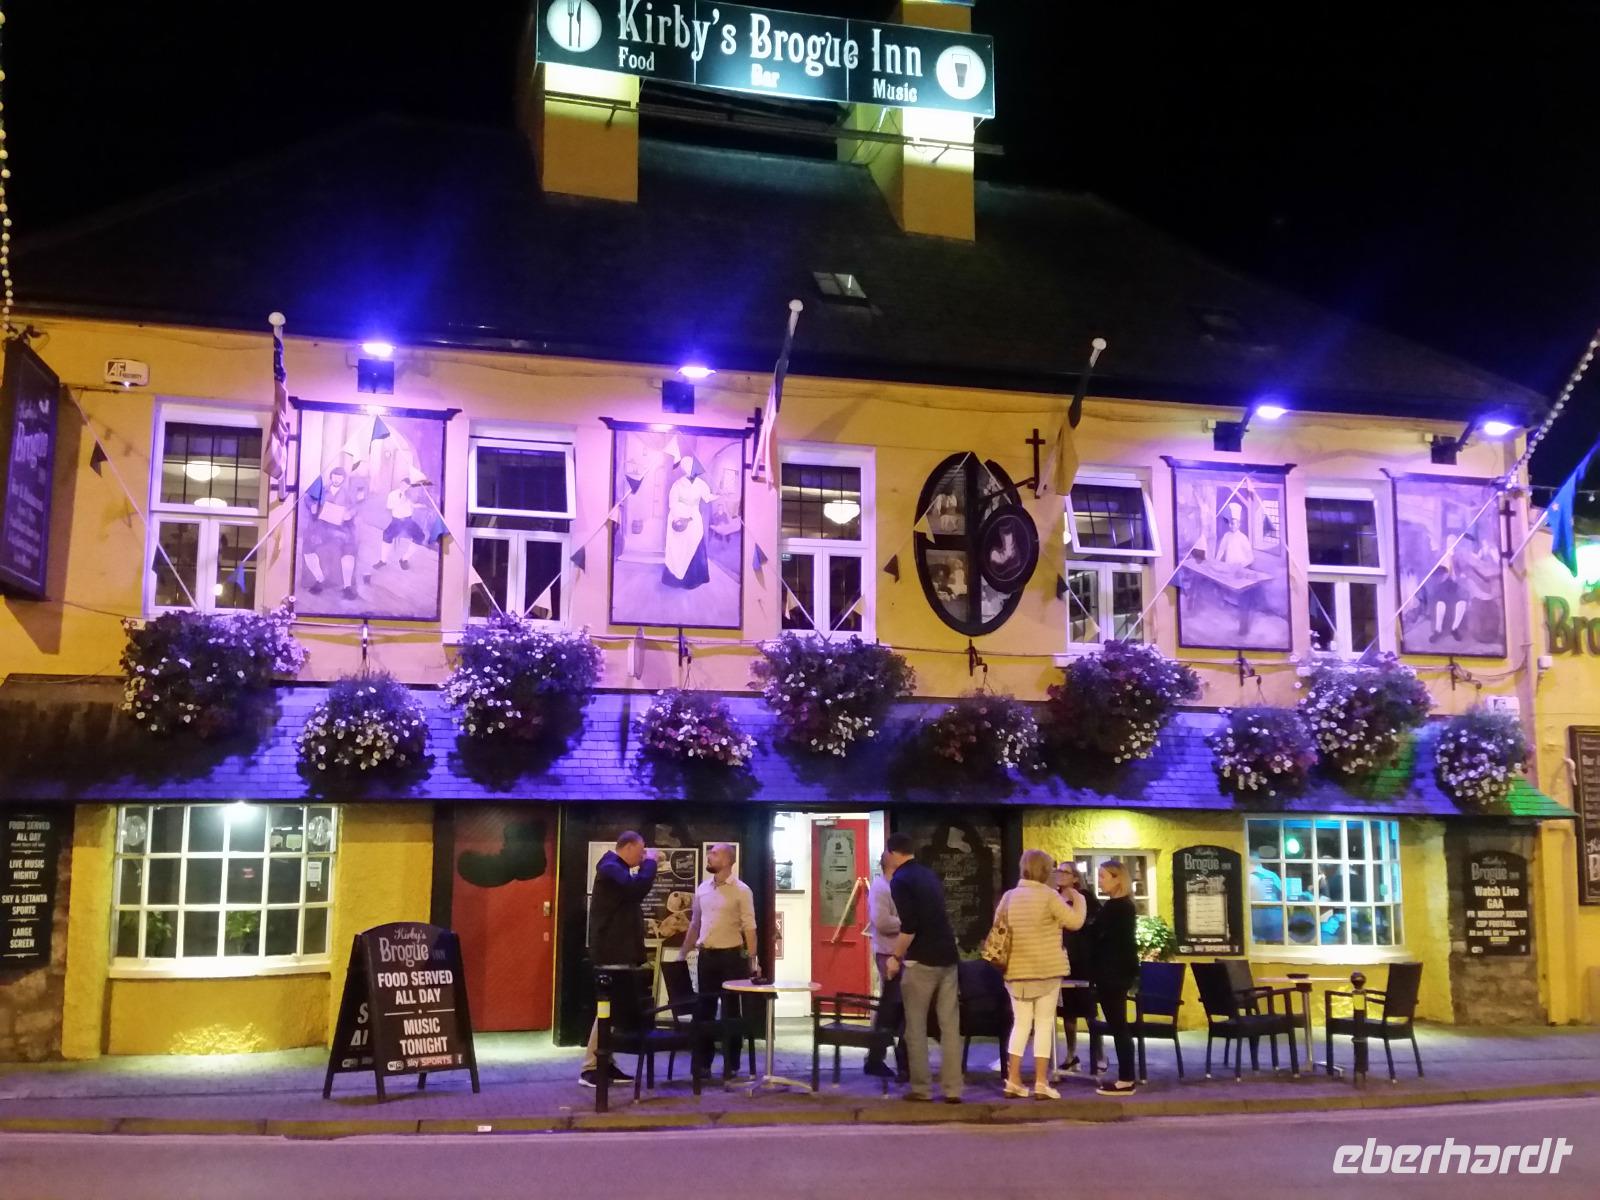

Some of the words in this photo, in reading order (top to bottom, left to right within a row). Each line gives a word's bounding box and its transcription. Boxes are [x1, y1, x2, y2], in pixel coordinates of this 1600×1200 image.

[618, 0, 737, 61] Kirby's
[750, 13, 859, 77] Brogue
[872, 29, 923, 77] Inn
[618, 46, 655, 71] Food
[751, 64, 780, 88] Bar
[873, 78, 918, 103] Music
[16, 832, 28, 841] ALL
[29, 832, 41, 841] DAY
[9, 859, 23, 869] LIVE
[24, 859, 45, 869] MUSIC
[1184, 853, 1220, 874] Brogue
[13, 870, 39, 880] NIGHTLY
[1474, 886, 1501, 897] Watch
[1502, 886, 1520, 896] Live
[1, 894, 14, 904] SKY
[1486, 898, 1504, 909] GAA
[12, 905, 37, 915] SPORTS
[12, 927, 33, 937] LARGE
[10, 938, 35, 949] SCREEN
[379, 937, 429, 968] Brogue
[377, 972, 408, 988] FOOD
[411, 970, 453, 986] SERVED
[395, 989, 416, 1005] ALL
[419, 988, 441, 1004] DAY
[403, 1017, 441, 1036] MUSIC
[400, 1036, 448, 1056] TONIGHT
[421, 1055, 452, 1066] SPORTS
